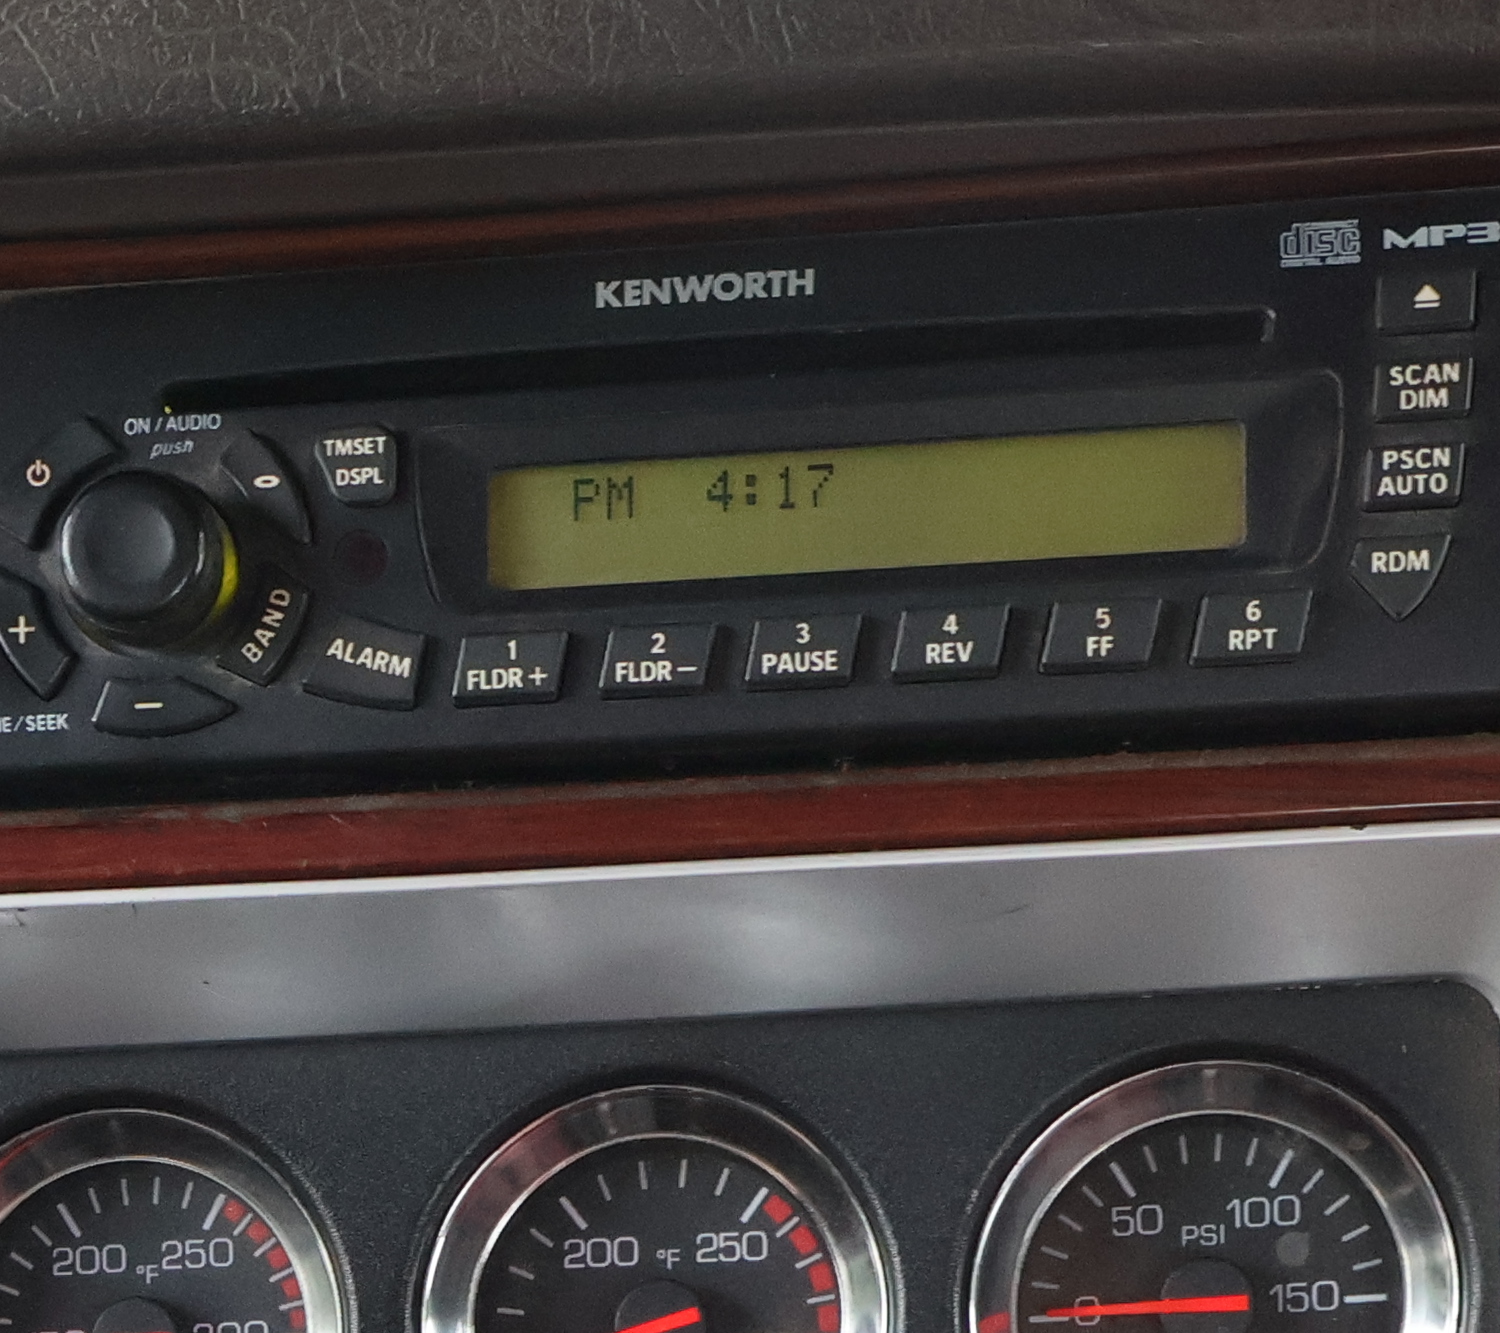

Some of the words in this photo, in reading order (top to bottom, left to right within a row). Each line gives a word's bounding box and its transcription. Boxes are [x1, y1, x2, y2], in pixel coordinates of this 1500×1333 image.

[595, 268, 815, 308] KENWORTH
[1389, 362, 1460, 387] SCAN
[1400, 388, 1449, 411] DIM
[149, 438, 194, 460] push
[323, 436, 387, 457] TMSET
[1382, 447, 1450, 471] PSCN
[335, 468, 384, 486] DSPL
[1377, 473, 1449, 497] AUTO
[573, 476, 634, 521] PM
[706, 464, 834, 512] 4:17
[1371, 549, 1431, 574] RDM
[1095, 607, 1112, 629] 5
[1245, 600, 1262, 622] 6
[241, 587, 291, 664] BAND
[796, 622, 811, 645] 3
[942, 614, 959, 635] 4
[507, 639, 518, 661] 1
[651, 632, 666, 654] 2
[1086, 636, 1114, 658] FF
[1228, 628, 1279, 652] RPT
[326, 637, 413, 679] ALARM
[761, 650, 839, 675] PAUSE
[925, 641, 975, 664] REV
[1111, 1204, 1163, 1236] 50
[1226, 1195, 1300, 1229] 100
[695, 1230, 769, 1263] 250
[1182, 1224, 1226, 1247] PSI
[52, 1244, 127, 1276] 200
[160, 1237, 234, 1270] 250
[563, 1236, 639, 1269] 200
[1269, 1280, 1340, 1314] 150
